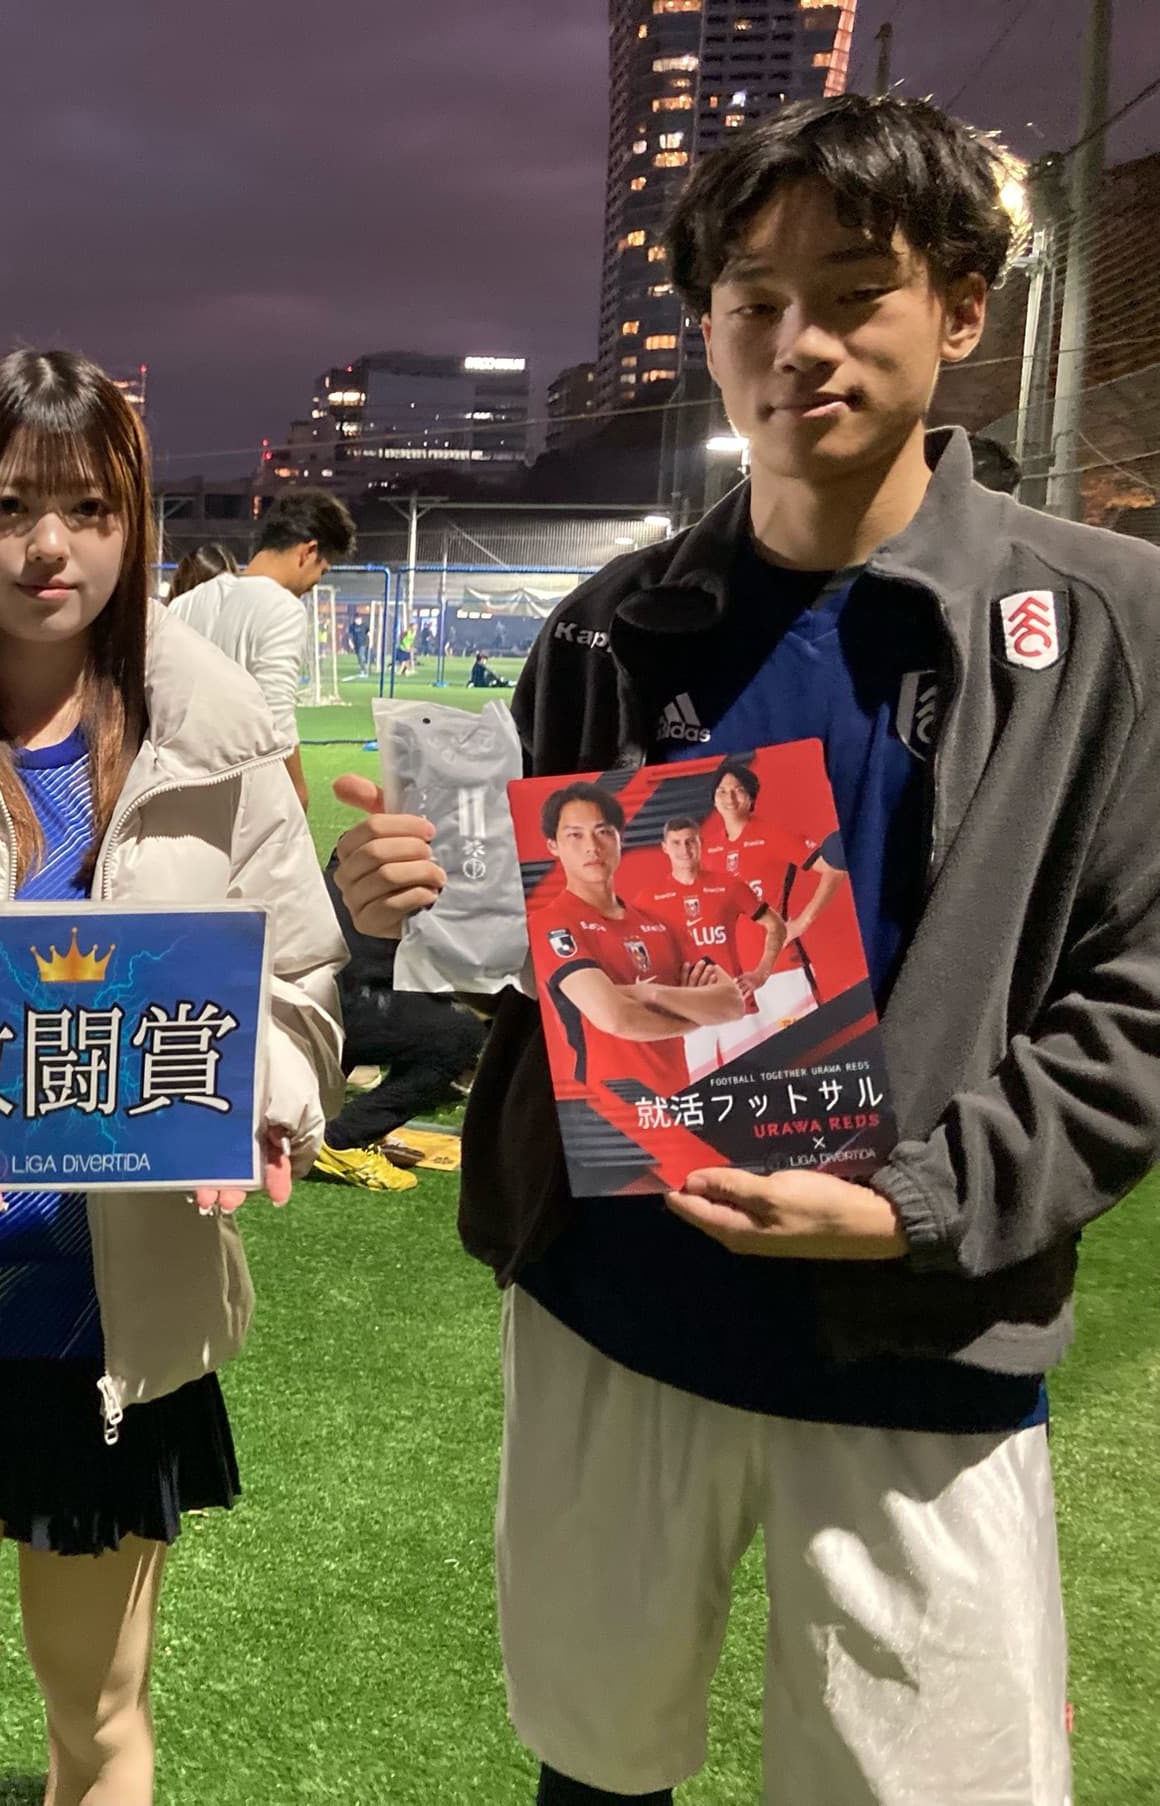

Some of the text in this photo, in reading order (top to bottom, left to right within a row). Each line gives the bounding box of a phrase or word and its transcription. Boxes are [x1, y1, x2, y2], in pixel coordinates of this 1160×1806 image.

[554, 621, 612, 653] Kap
[710, 1061, 870, 1087] FOOTBALL TOGETHER URAWA REDS
[634, 1076, 884, 1130] 就活フットサル
[753, 1112, 880, 1139] URAWA REDS
